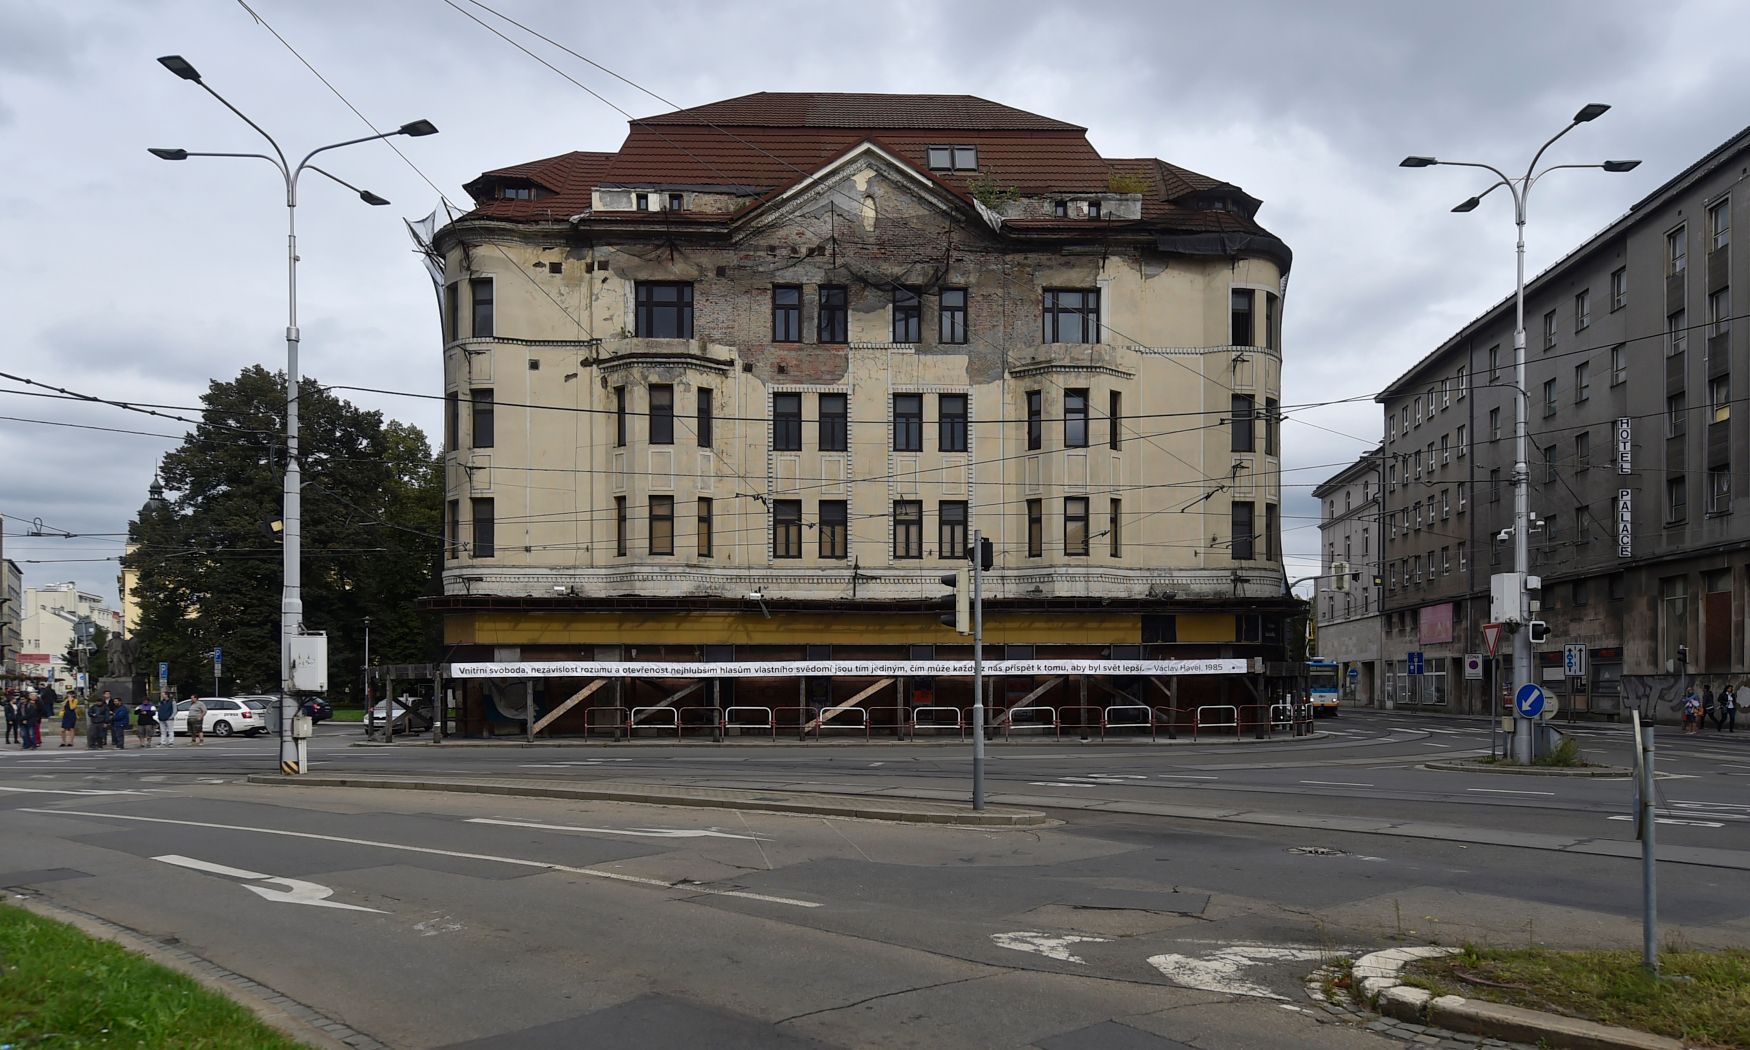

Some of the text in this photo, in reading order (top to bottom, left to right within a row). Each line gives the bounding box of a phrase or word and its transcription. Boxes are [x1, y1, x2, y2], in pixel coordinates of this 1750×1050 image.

[1620, 418, 1630, 556] HOTEL PALACE
[458, 666, 487, 674] Vnitřní
[489, 666, 529, 675] svoboda,
[530, 666, 578, 674] nezávislost
[622, 666, 669, 674] otevřenost
[670, 666, 718, 676] nejhlubším
[720, 666, 752, 674] hlasům
[754, 666, 794, 674] vlastního
[796, 665, 833, 673] svědomí
[834, 665, 852, 674] jsou
[870, 665, 908, 674] jediným,
[910, 664, 925, 672] čím
[927, 664, 950, 672] může
[1070, 664, 1086, 673] aby
[1088, 664, 1101, 673] byl
[1122, 664, 1145, 673] lepší.
